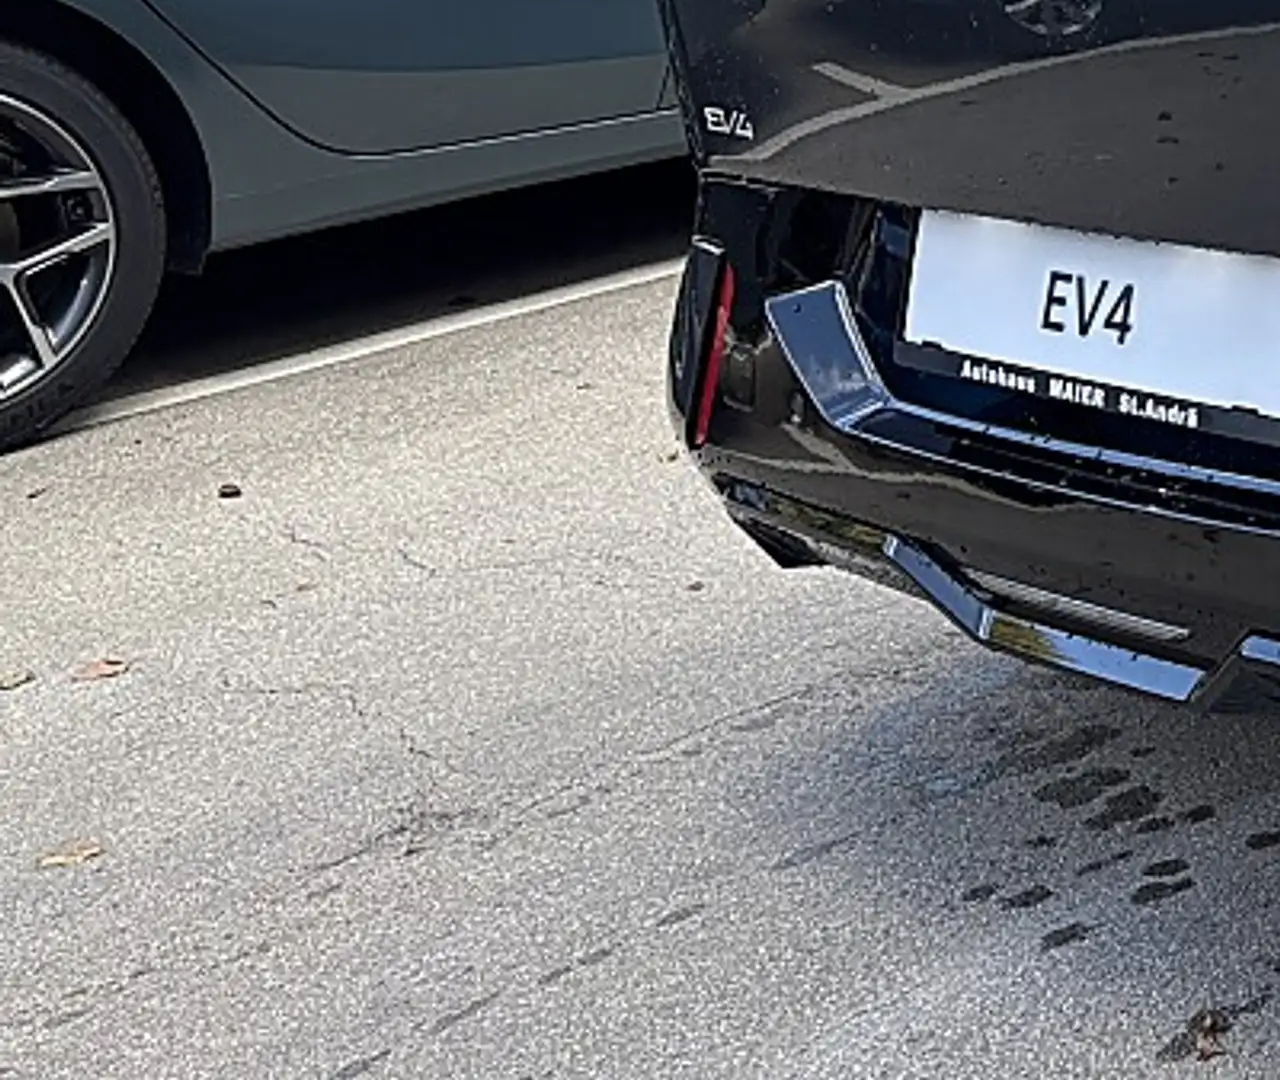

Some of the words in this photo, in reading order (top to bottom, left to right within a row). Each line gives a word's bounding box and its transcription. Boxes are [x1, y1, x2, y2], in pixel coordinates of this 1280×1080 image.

[704, 107, 753, 140] EV4
[1041, 270, 1134, 345] EV4
[960, 359, 1036, 394] Autohaus
[1050, 378, 1106, 409] MAIER
